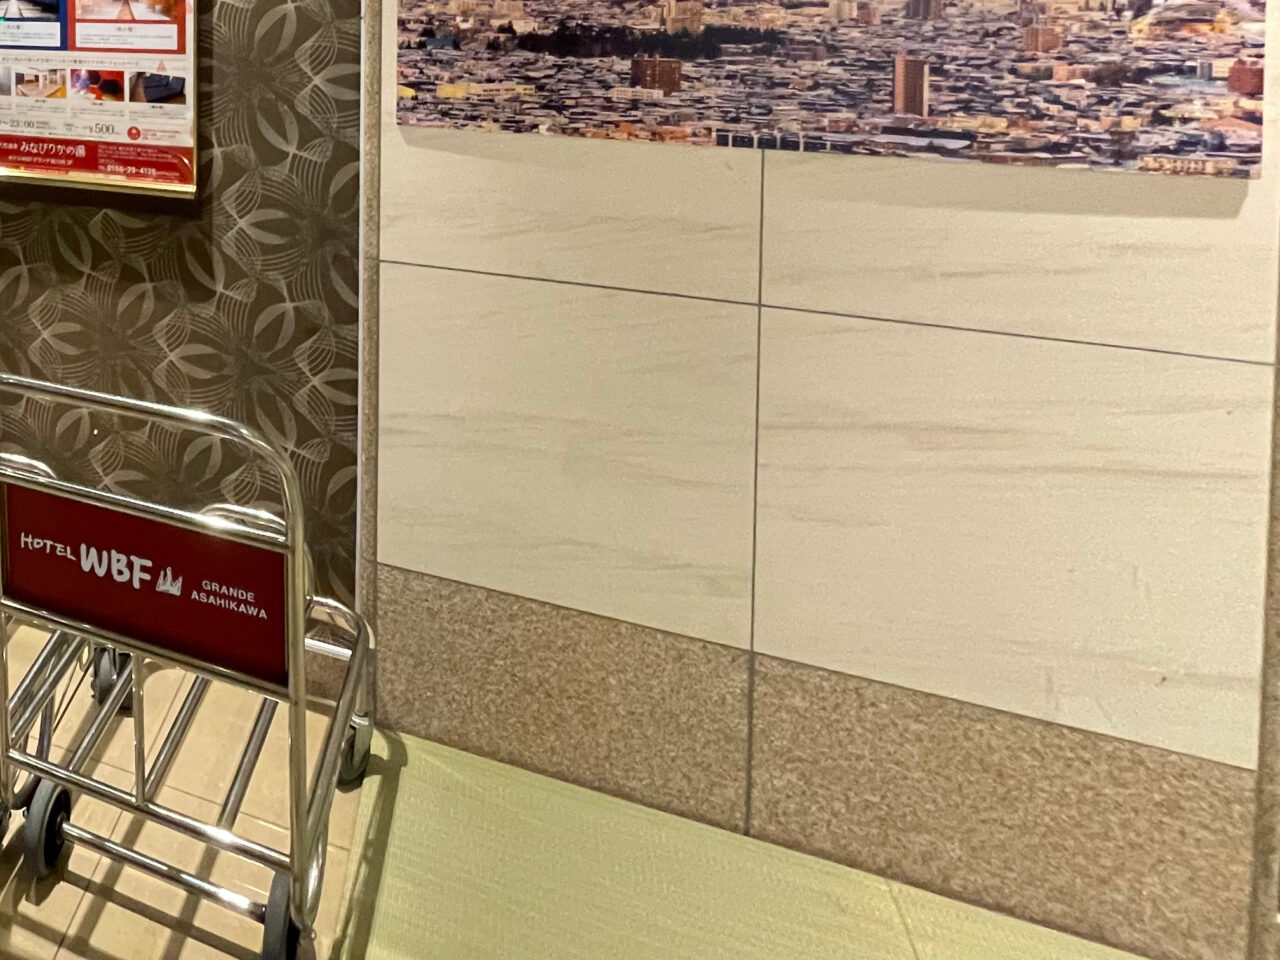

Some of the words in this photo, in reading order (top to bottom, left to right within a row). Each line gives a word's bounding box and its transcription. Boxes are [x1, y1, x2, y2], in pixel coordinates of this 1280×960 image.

[20, 532, 76, 560] HOTEL
[80, 542, 153, 590] WBF
[191, 590, 268, 619] ASAHIKAWA
[201, 580, 255, 602] GRANDE
